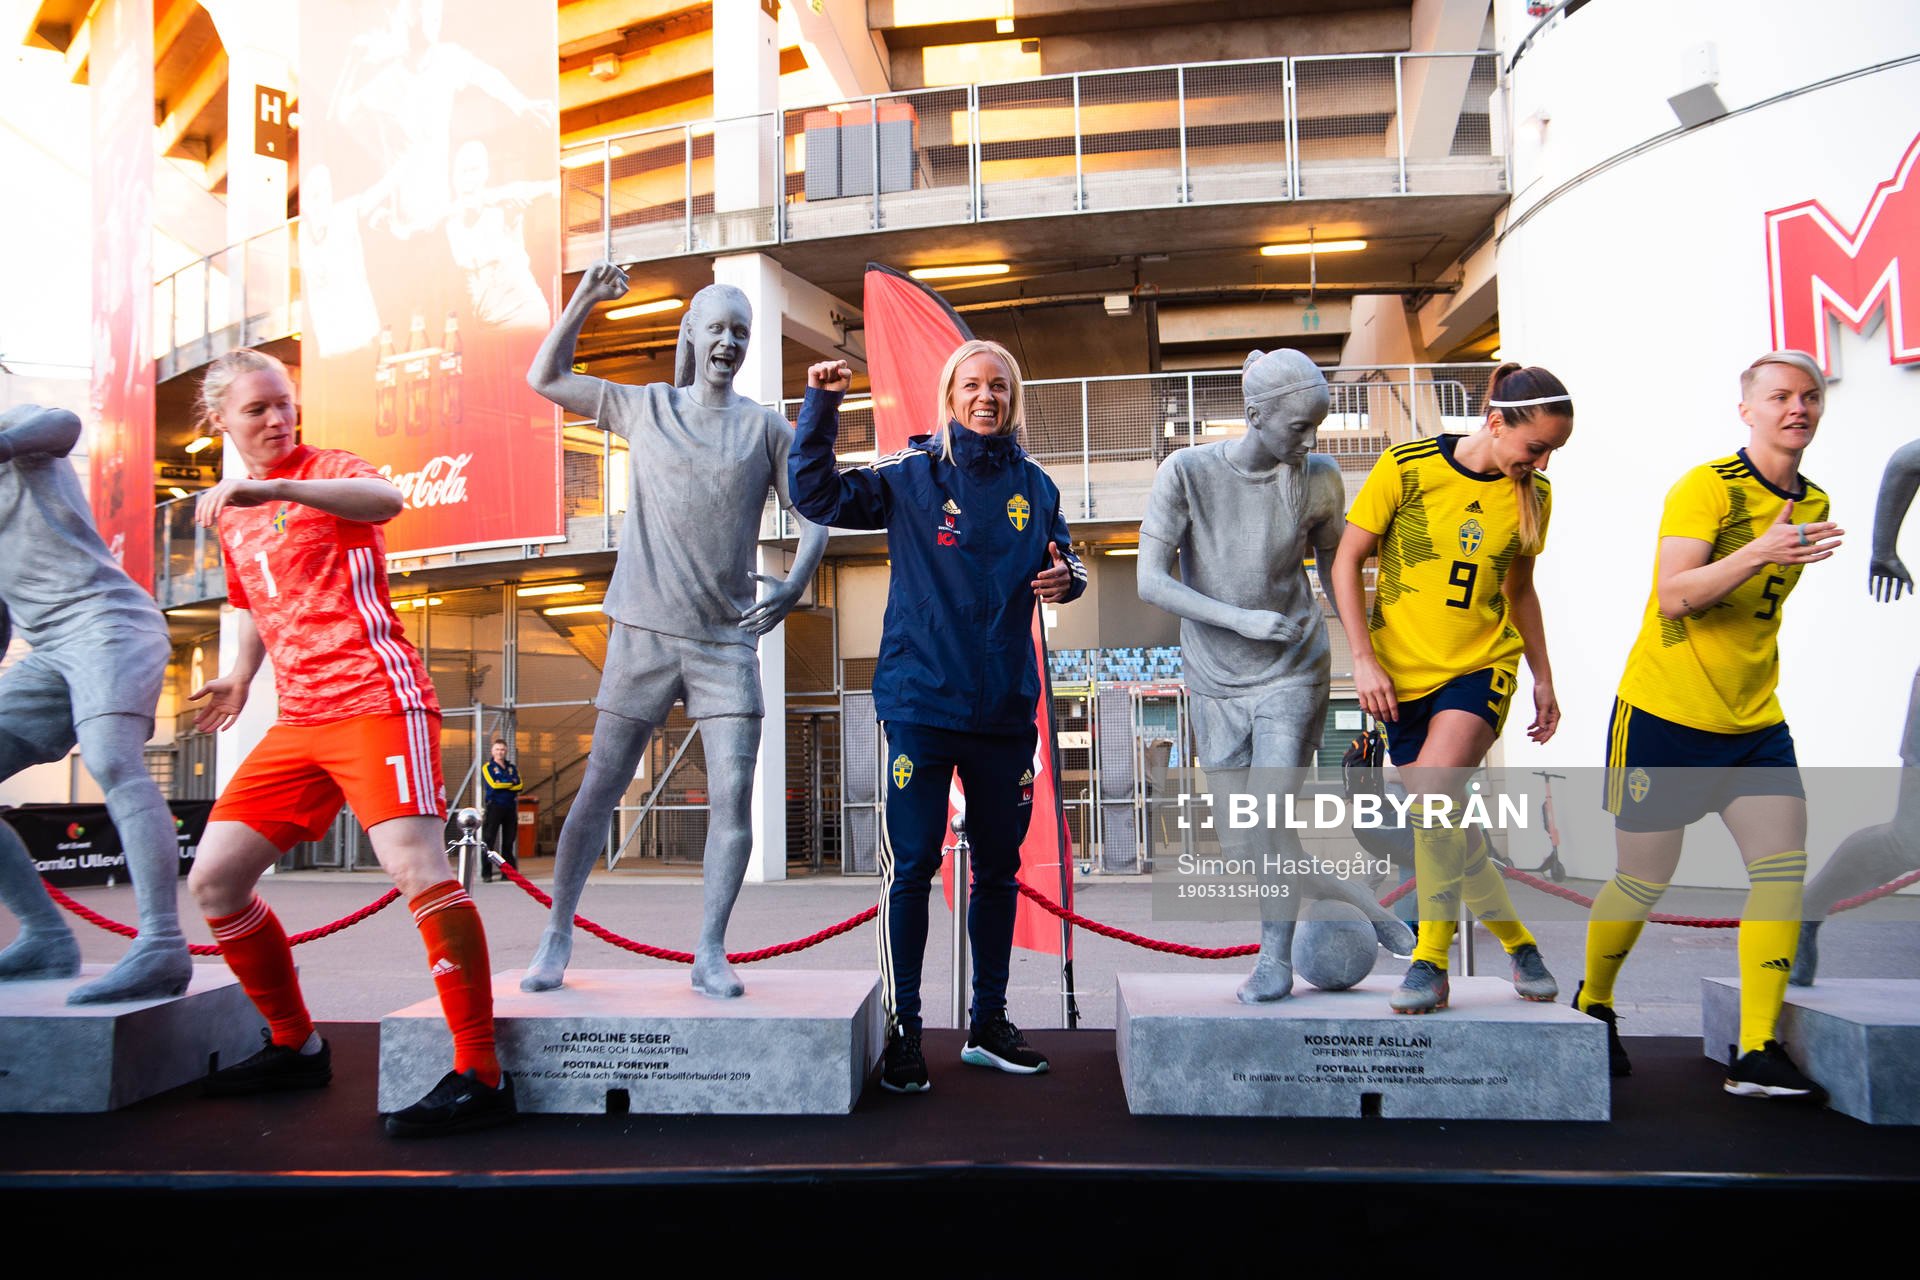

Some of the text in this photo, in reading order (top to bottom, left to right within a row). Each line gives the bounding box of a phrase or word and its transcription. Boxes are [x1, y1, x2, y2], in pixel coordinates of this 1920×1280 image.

[260, 92, 282, 125] H
[254, 550, 278, 598] 1
[1446, 560, 1478, 609] 9
[1754, 575, 1785, 620] 5
[1487, 667, 1509, 715] 9
[385, 755, 411, 804] 1
[561, 1032, 671, 1044] CAROLINE SEGER
[1304, 1035, 1432, 1048] KOSOVARE ASLLANI
[563, 1061, 615, 1069] FOOTBALL
[729, 1072, 751, 1081] 2019
[1316, 1064, 1369, 1074] FOOTBALL
